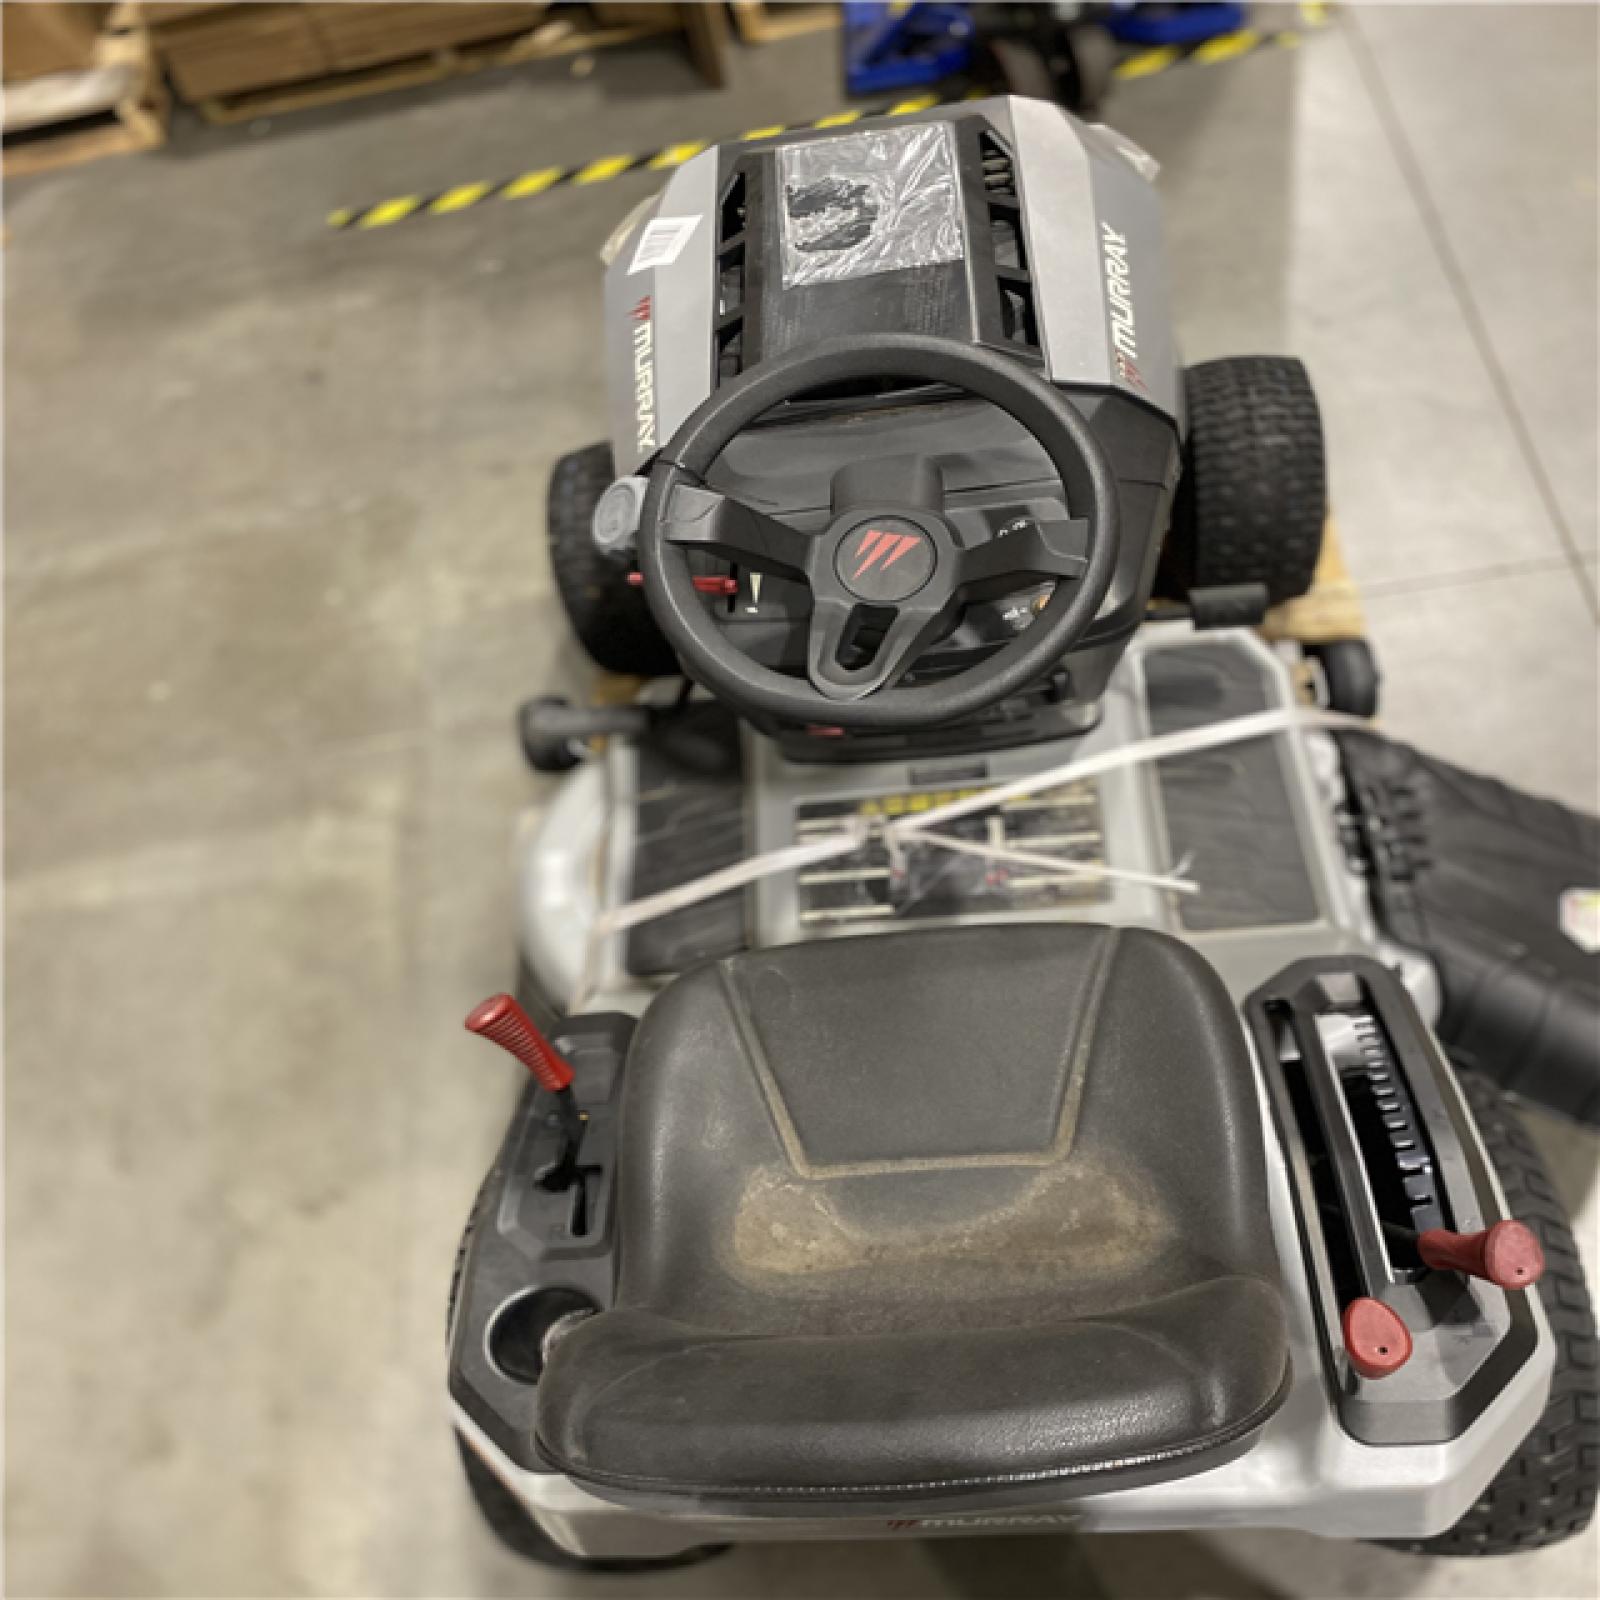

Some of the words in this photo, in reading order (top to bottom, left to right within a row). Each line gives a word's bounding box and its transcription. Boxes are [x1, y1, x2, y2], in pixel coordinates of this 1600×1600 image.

[1101, 221, 1138, 359] MURRAY
[633, 319, 656, 453] MURRAY
[922, 1514, 1081, 1528] MURRAY
